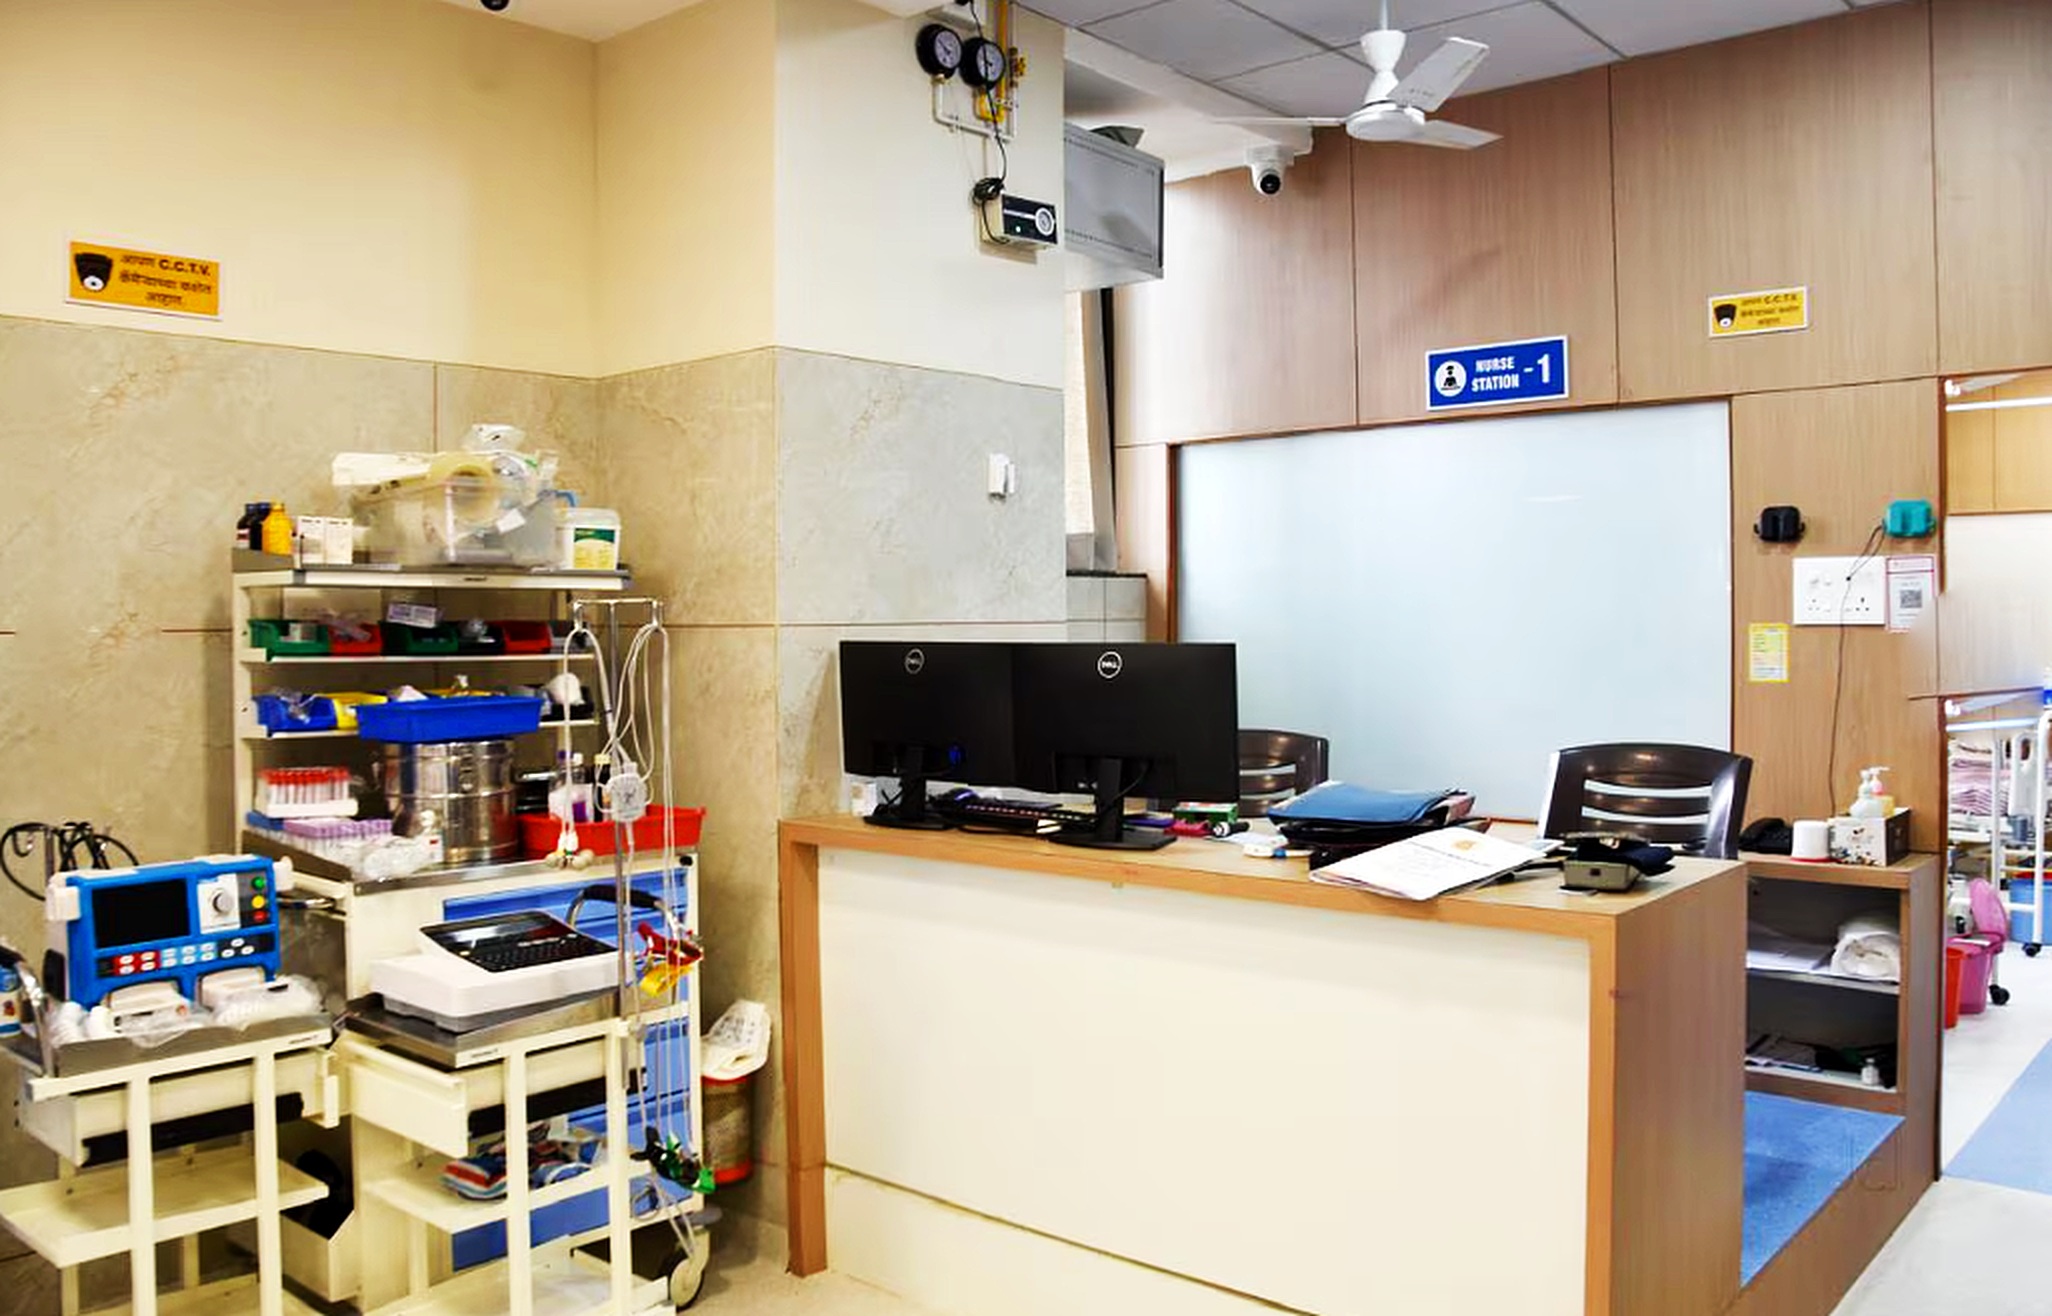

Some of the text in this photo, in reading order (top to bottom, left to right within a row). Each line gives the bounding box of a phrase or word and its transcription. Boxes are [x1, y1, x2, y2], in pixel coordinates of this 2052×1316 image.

[158, 258, 211, 276] C.C.T.V.
[1475, 355, 1516, 373] NURSE
[1471, 373, 1520, 392] STATION
